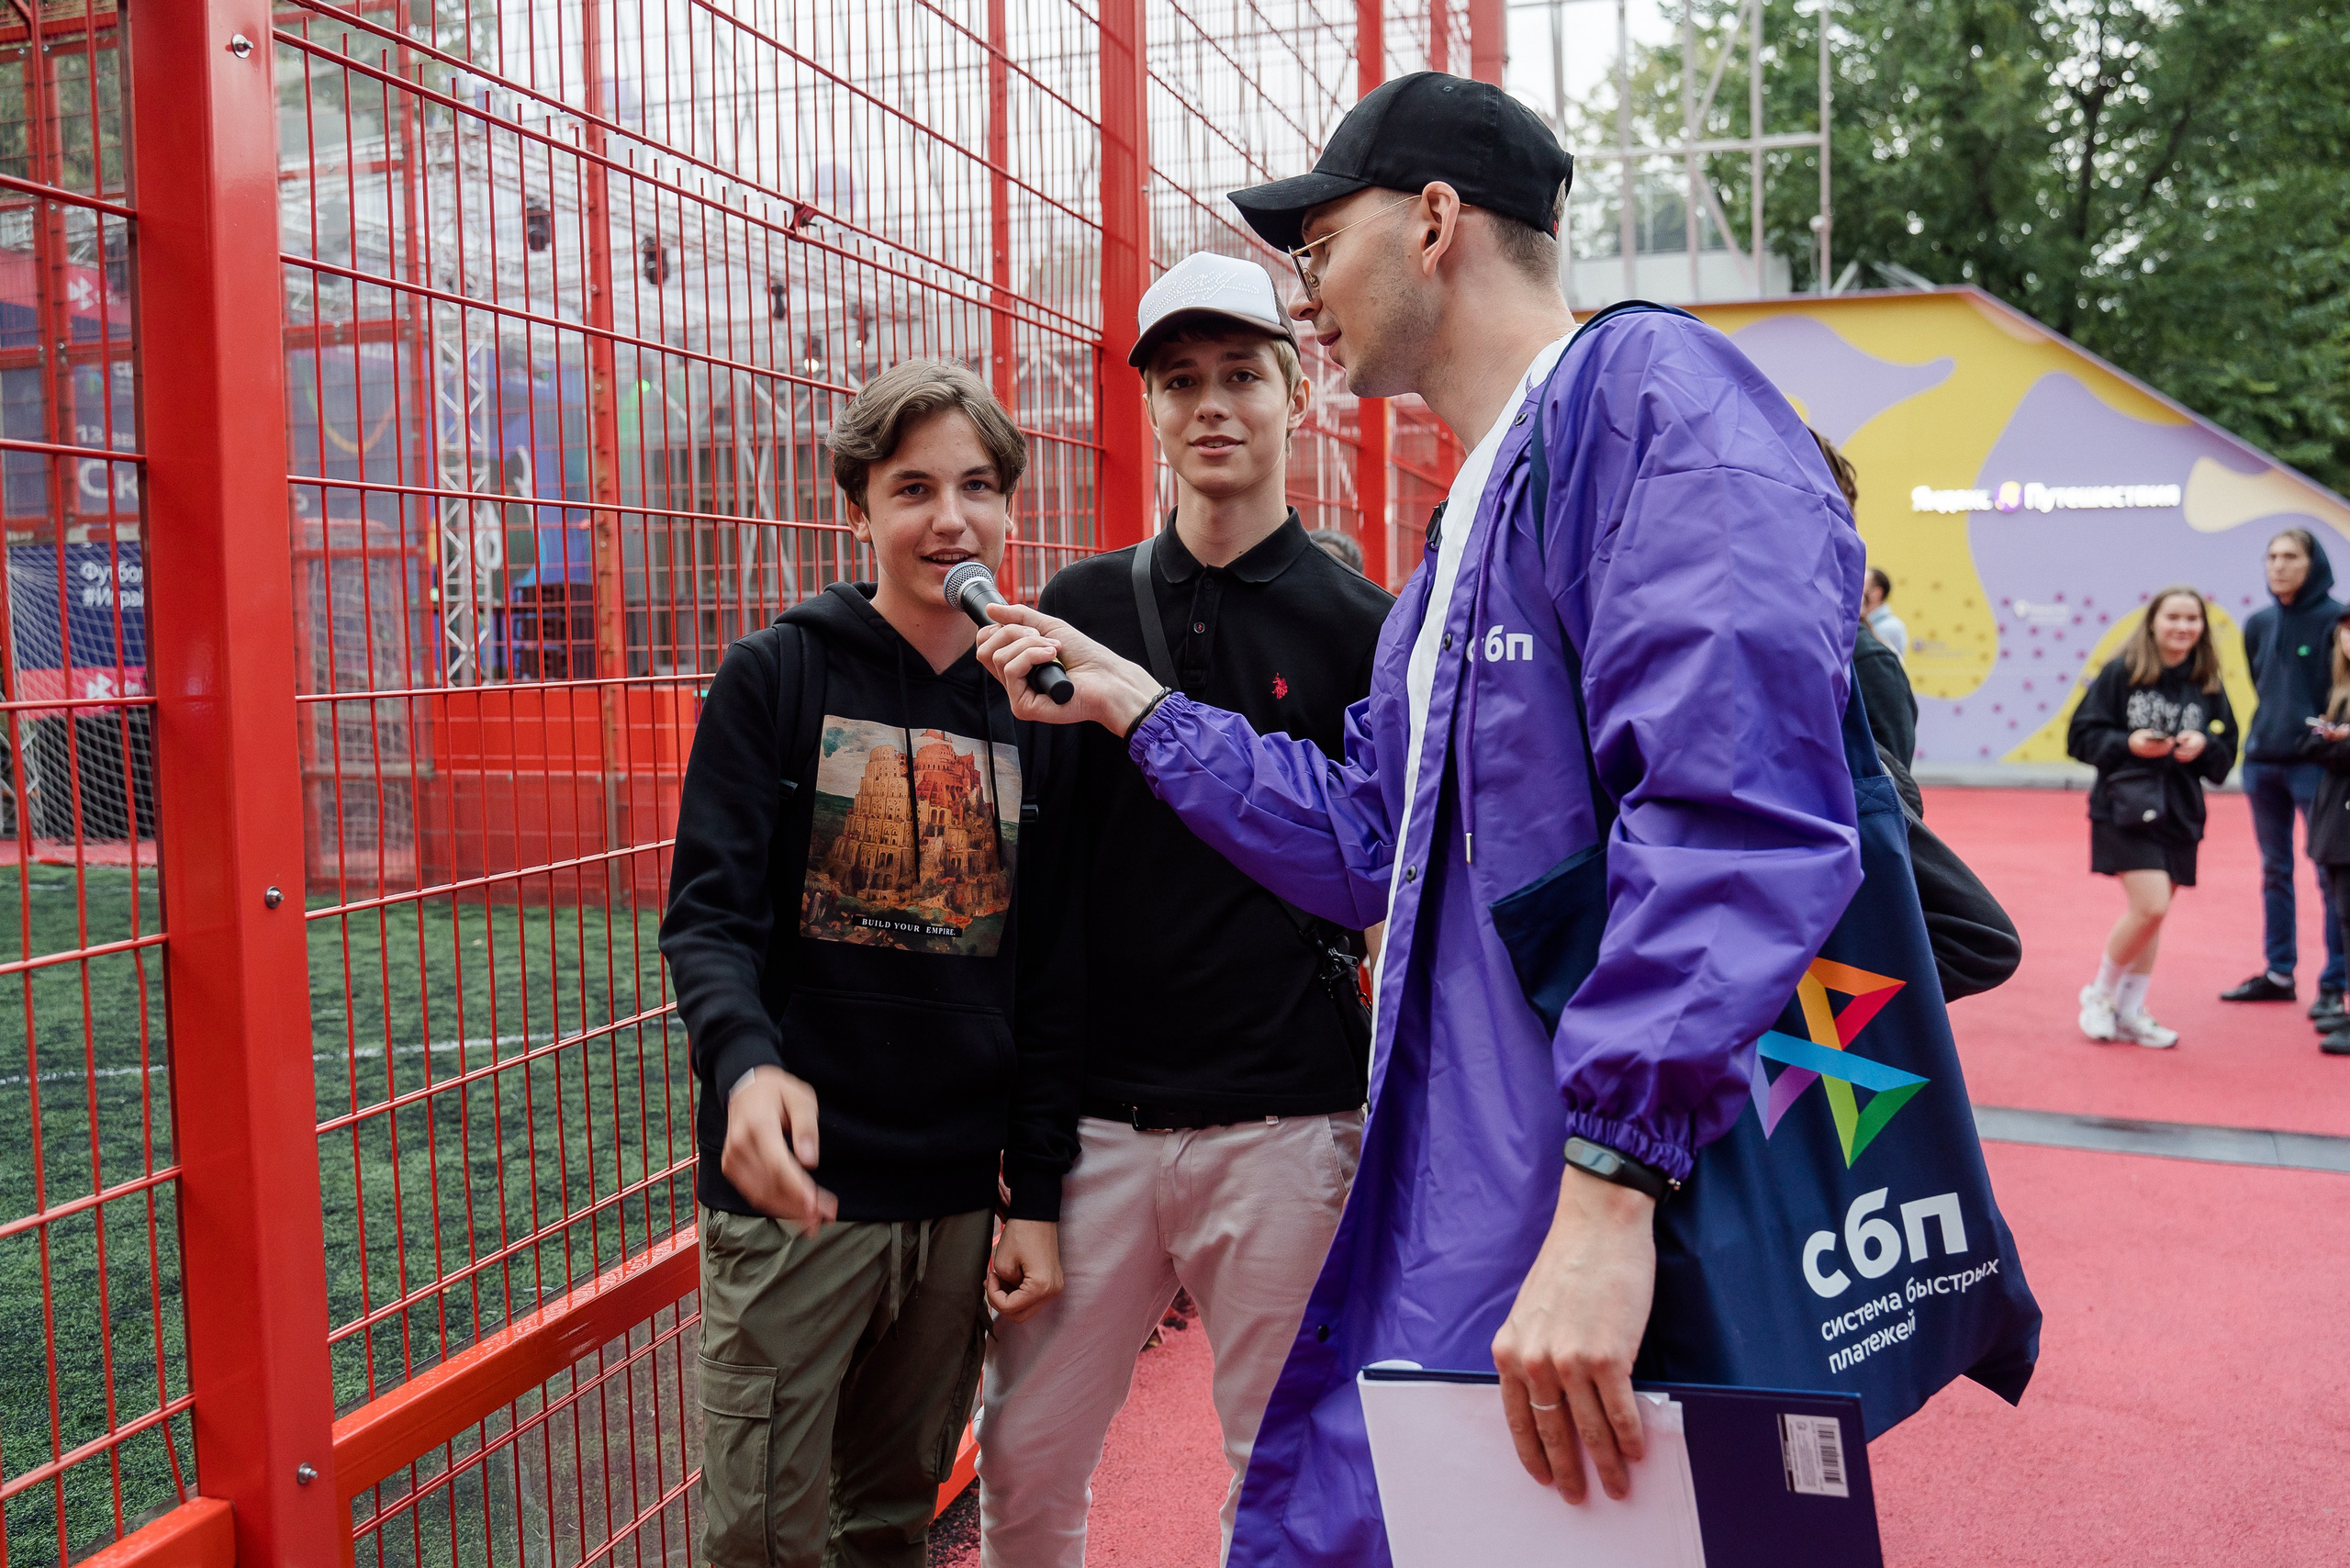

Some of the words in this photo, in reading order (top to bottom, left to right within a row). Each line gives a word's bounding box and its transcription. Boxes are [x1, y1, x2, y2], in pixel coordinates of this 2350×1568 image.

[861, 918, 891, 929] BUILD
[893, 923, 920, 933] YOUR
[925, 926, 957, 936] EMPIRE.
[1802, 1186, 1968, 1298] сбп
[1821, 1292, 1903, 1341] система
[1905, 1259, 1999, 1304] быстрых
[1829, 1308, 1916, 1374] платежей
